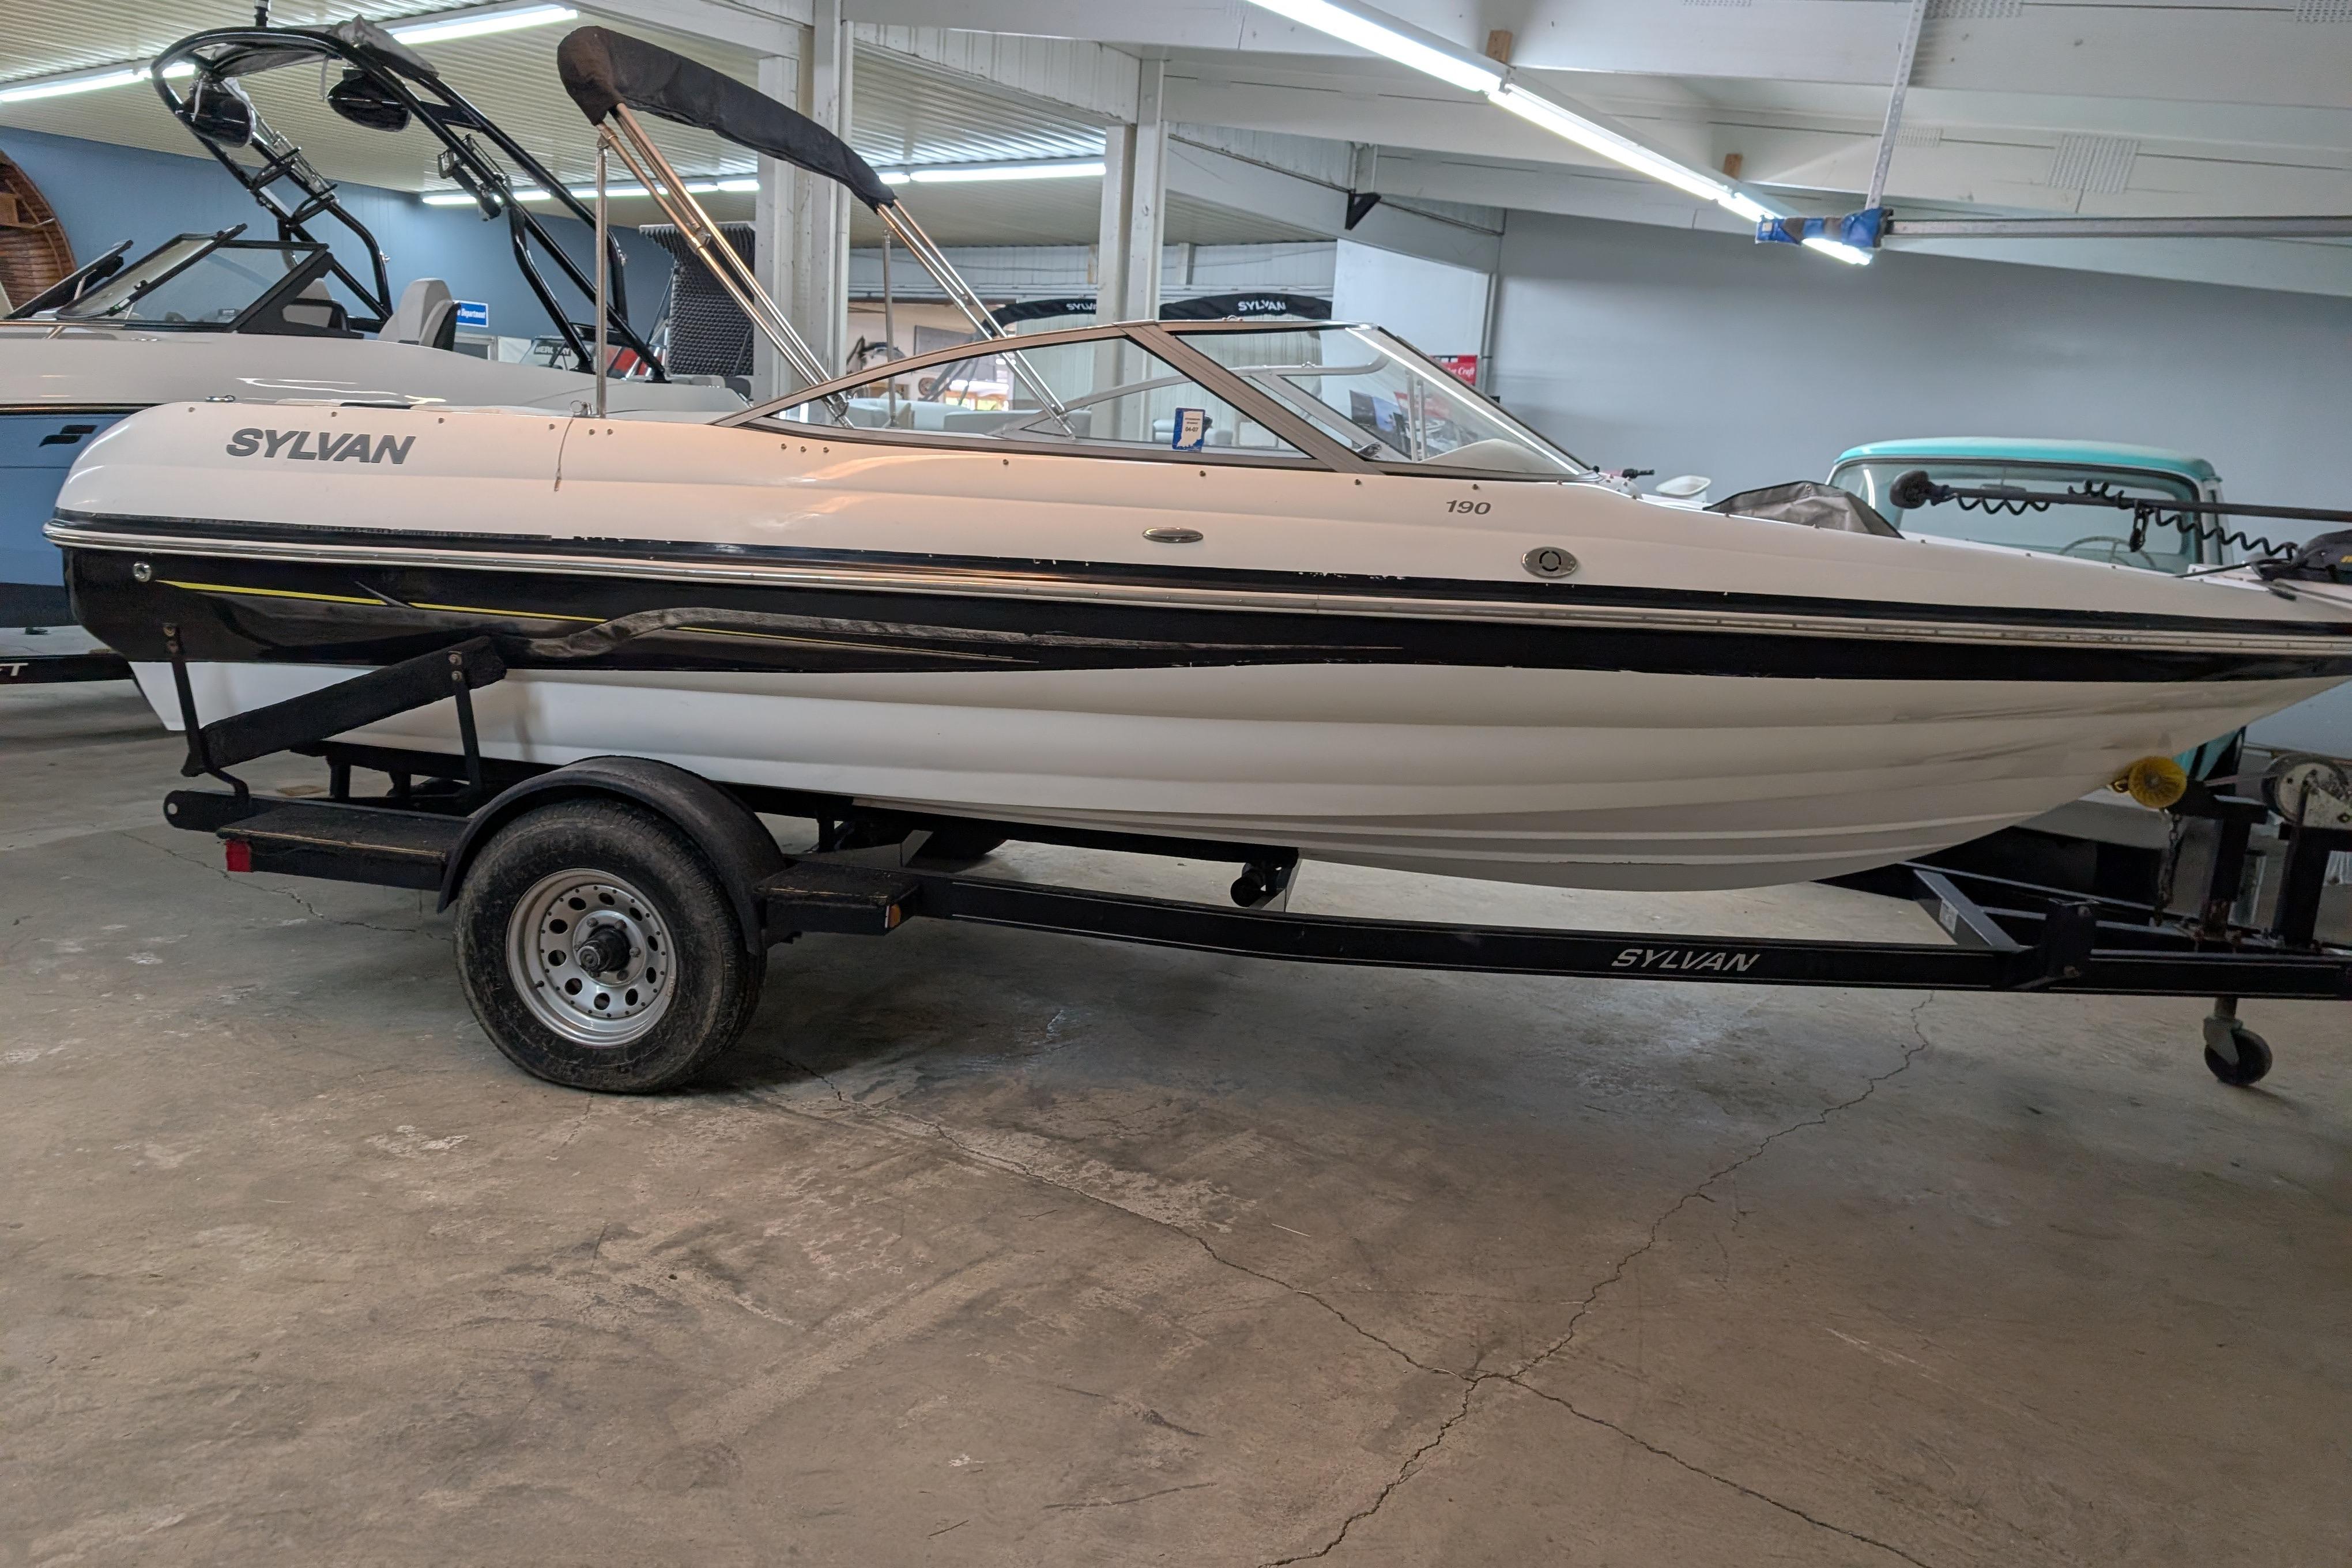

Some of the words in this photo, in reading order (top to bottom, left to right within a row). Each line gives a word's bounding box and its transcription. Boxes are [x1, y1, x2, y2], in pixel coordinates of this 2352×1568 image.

[1238, 300, 1287, 311] SYLVAN
[227, 428, 417, 465] SYLVAN
[1446, 500, 1491, 515] 190
[1611, 948, 1761, 971] SYLVAN
